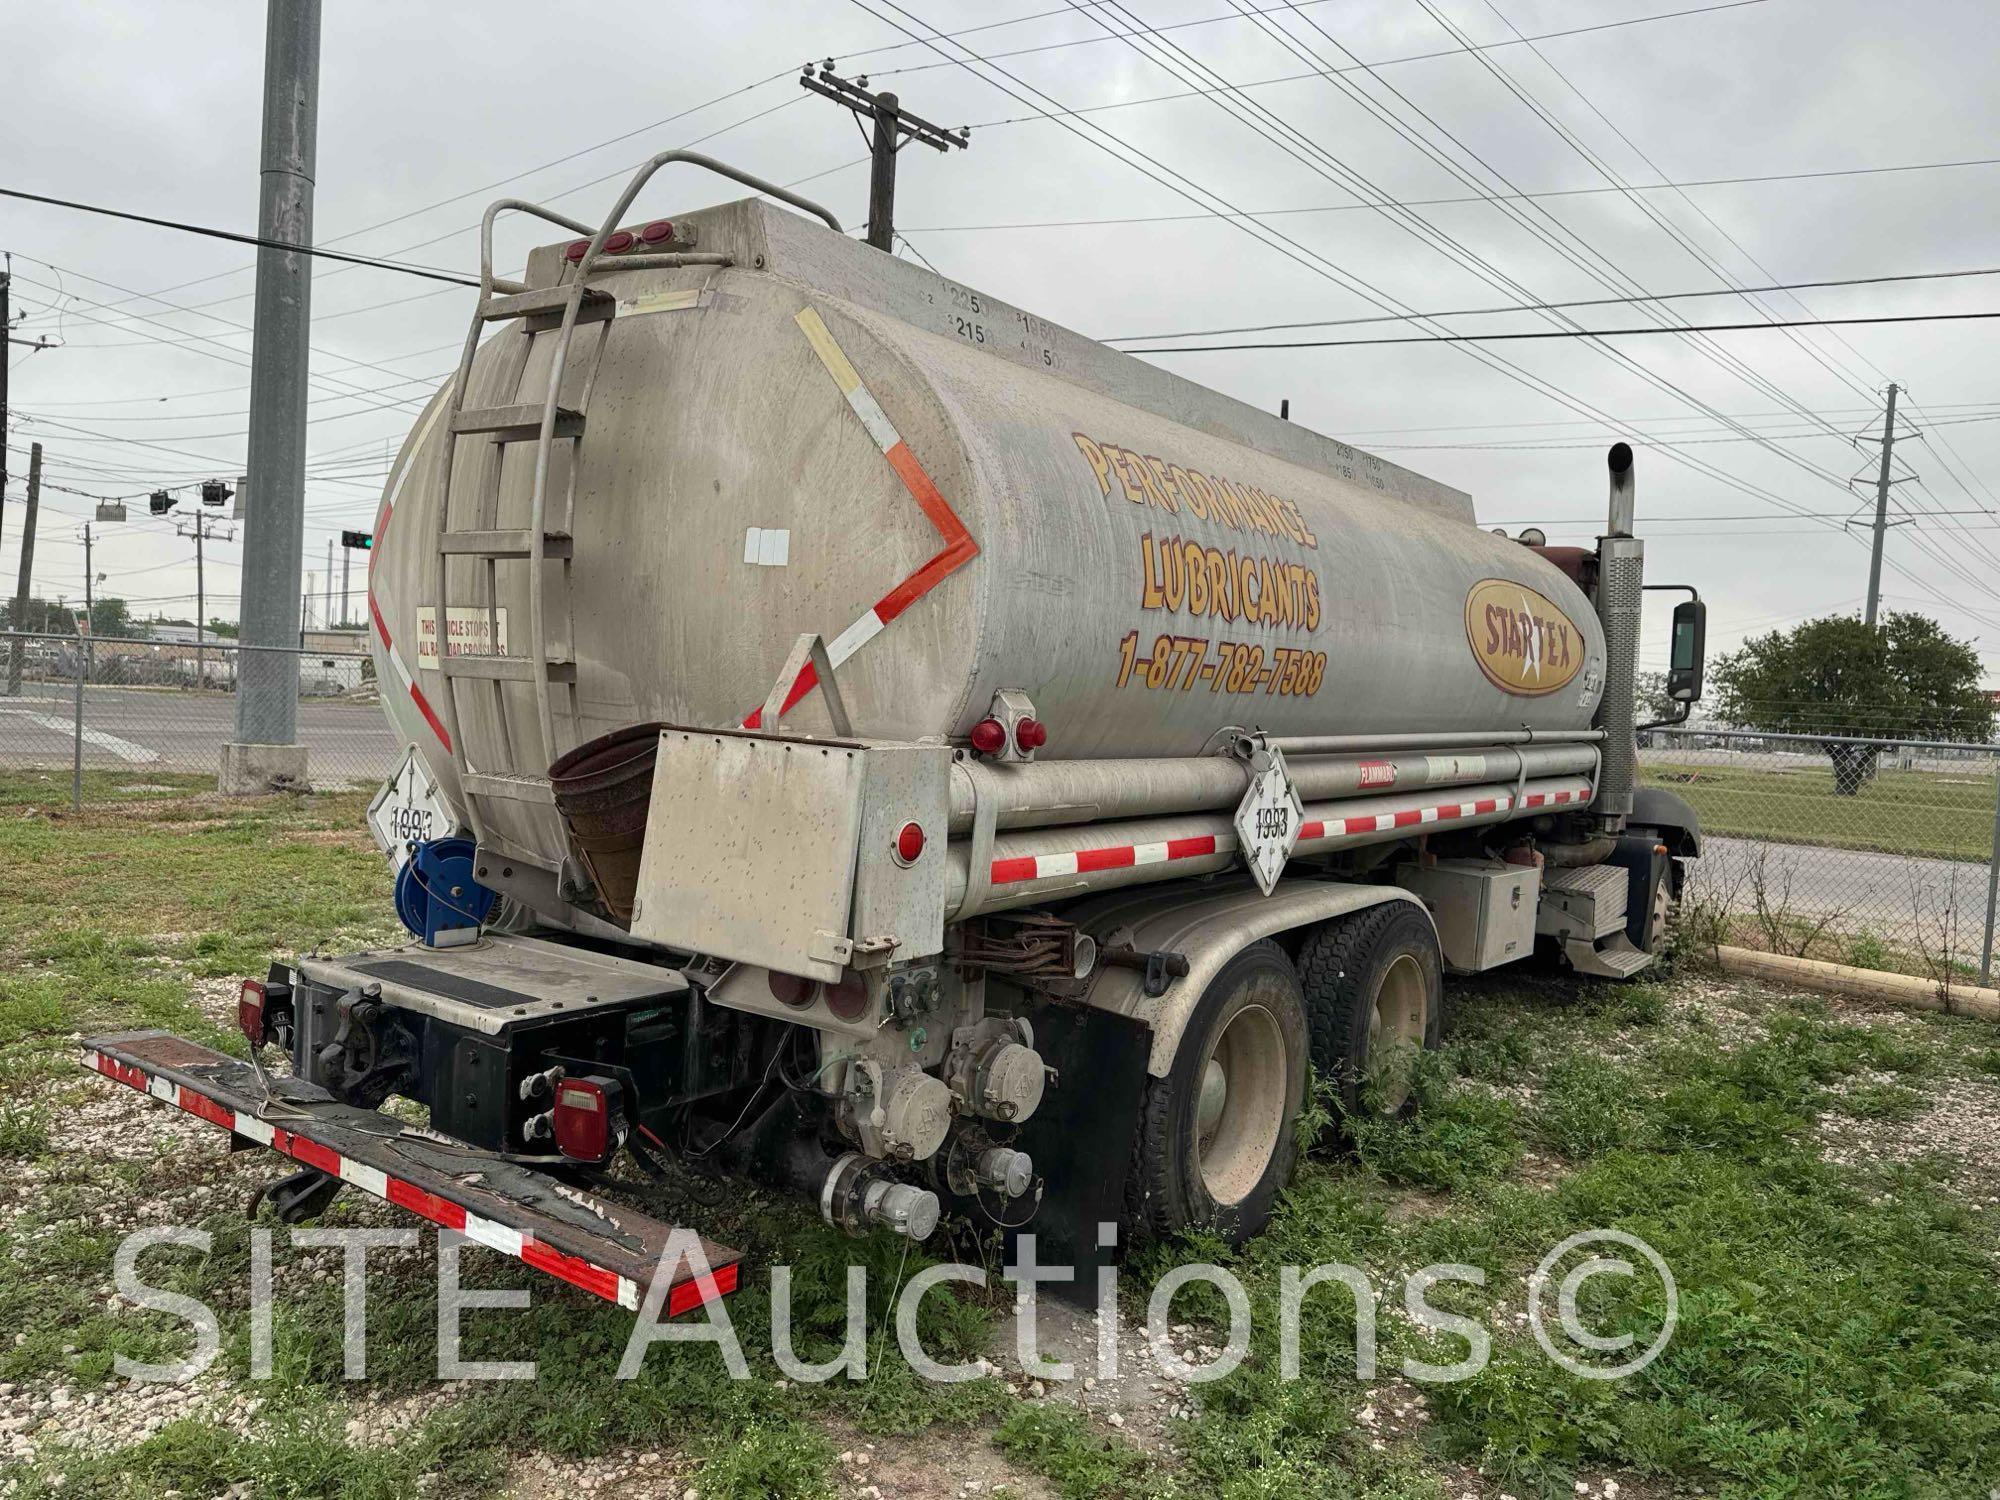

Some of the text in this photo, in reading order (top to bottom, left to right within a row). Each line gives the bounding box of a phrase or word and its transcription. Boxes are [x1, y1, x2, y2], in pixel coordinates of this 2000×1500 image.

[1072, 432, 1318, 550] PERFORMANCE
[1141, 530, 1321, 632] LUBRICANTS
[421, 619, 436, 635] THIS
[465, 620, 489, 637] STOPS
[1485, 603, 1571, 671] STARTEX
[1116, 630, 1327, 697] 1-877-782-7588
[391, 807, 433, 842] 1993
[1255, 807, 1288, 839] 1993
